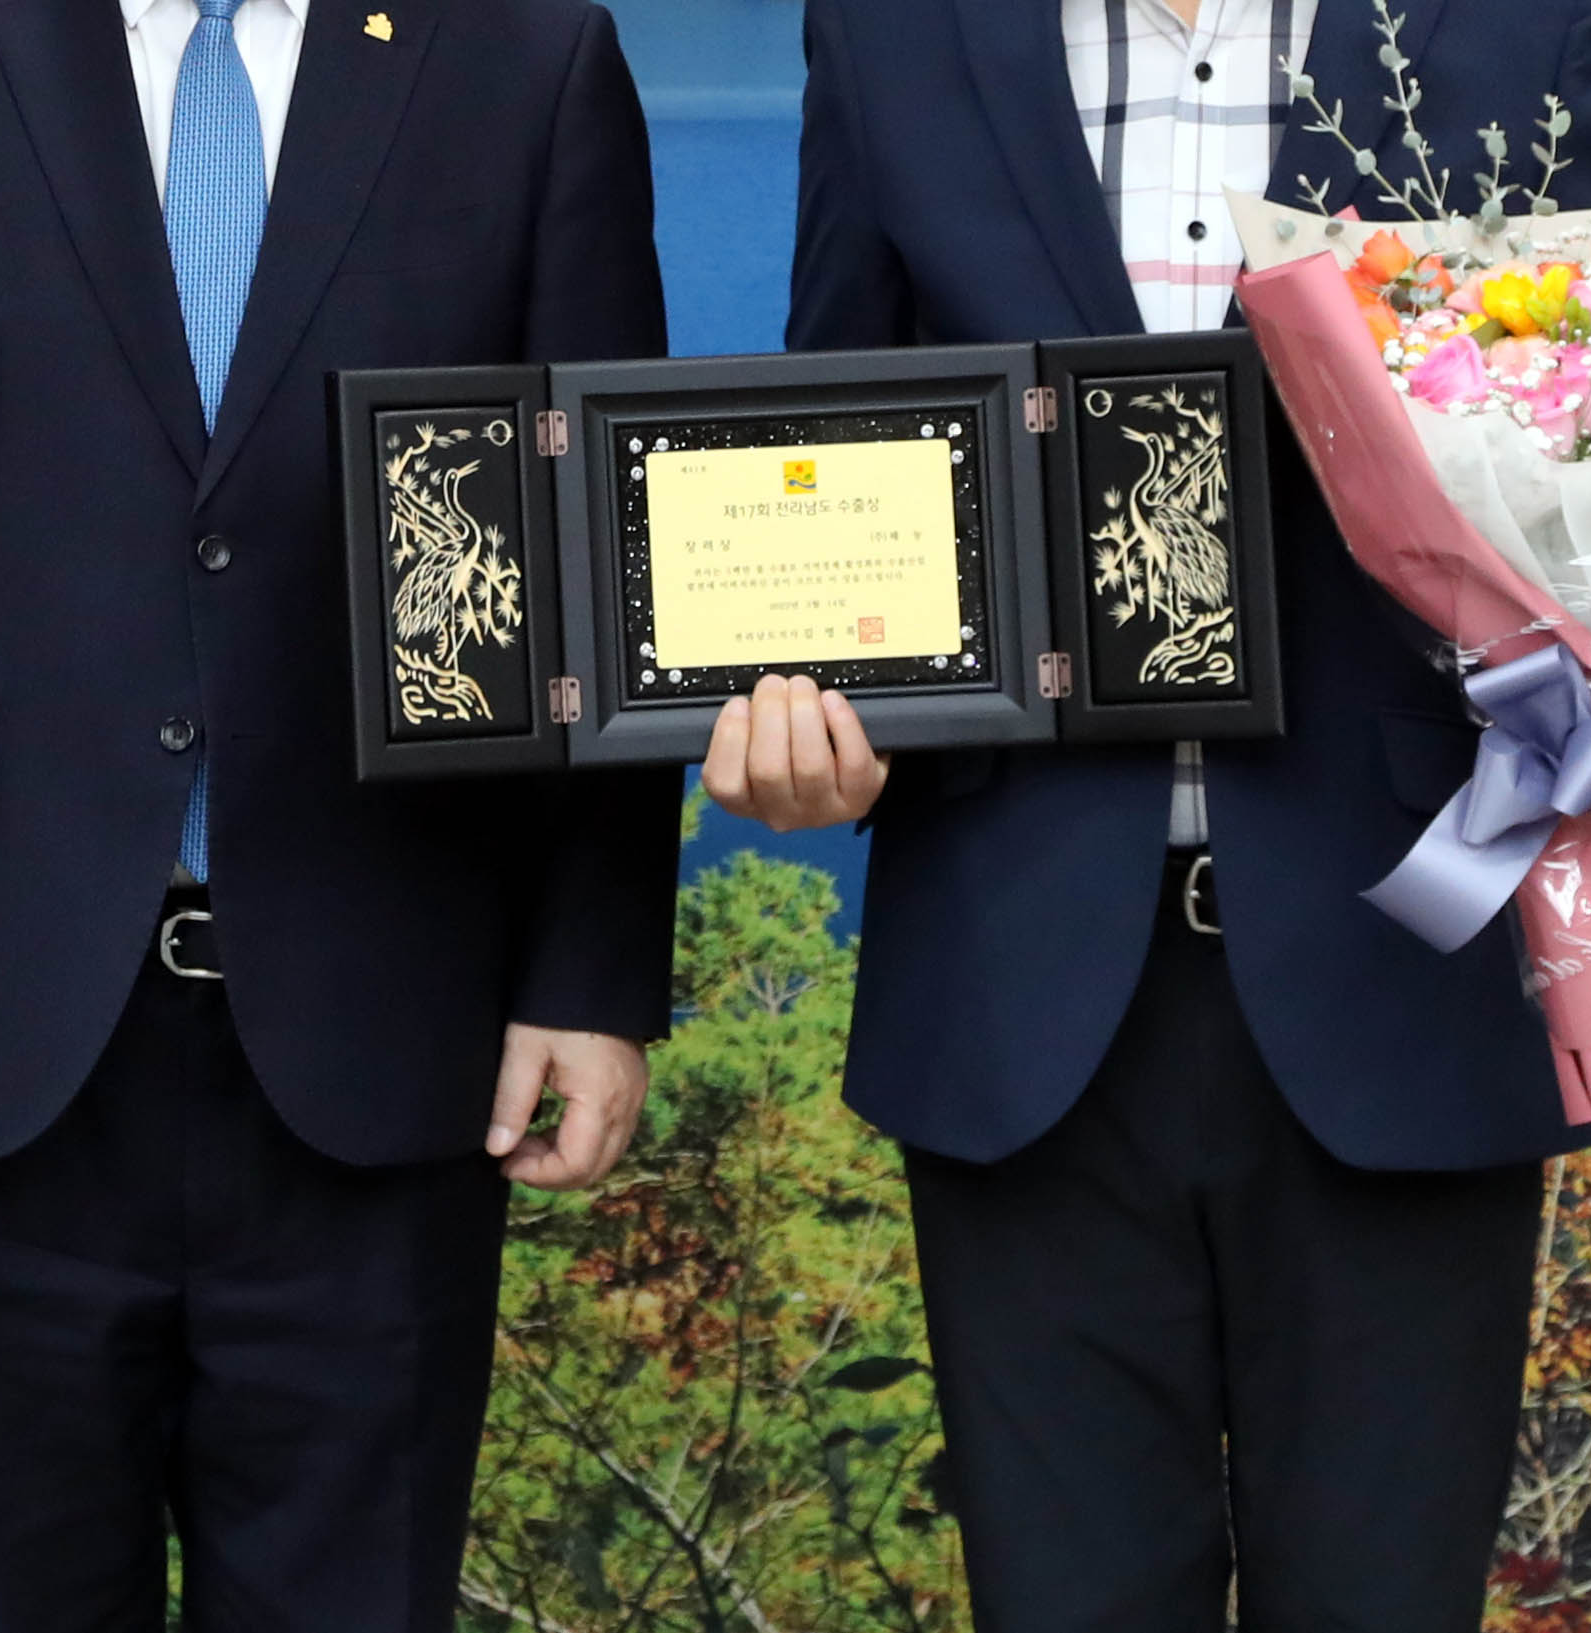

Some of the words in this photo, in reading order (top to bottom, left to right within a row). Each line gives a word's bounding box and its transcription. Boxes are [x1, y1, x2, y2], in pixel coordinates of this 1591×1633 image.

[723, 503, 771, 519] 제17회
[775, 499, 832, 518] 전라남도
[837, 496, 880, 514] 수출상
